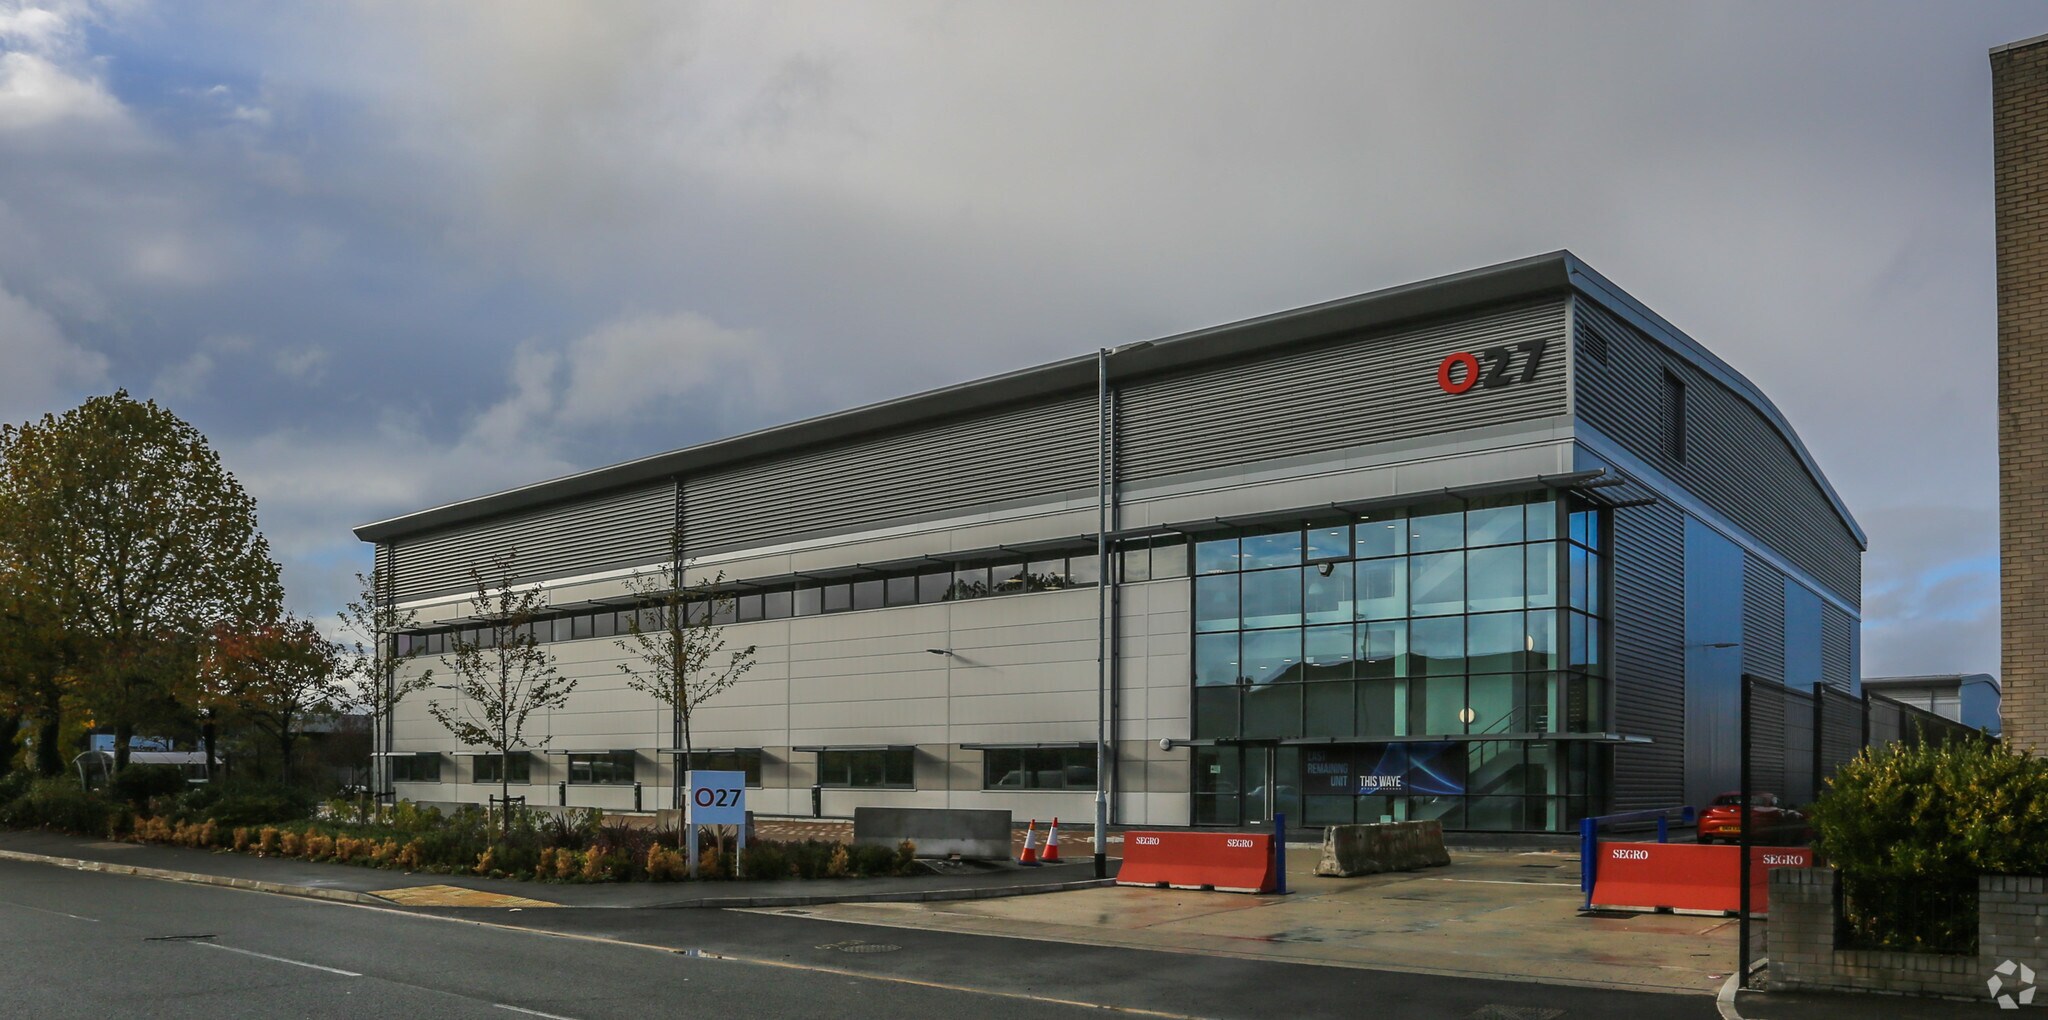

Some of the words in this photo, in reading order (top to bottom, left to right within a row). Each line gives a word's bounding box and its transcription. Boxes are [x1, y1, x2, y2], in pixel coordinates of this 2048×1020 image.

[1307, 763, 1348, 774] REMAINING
[1330, 775, 1348, 787] UNIT
[1360, 775, 1377, 787] THIS
[1379, 775, 1401, 787] WAYE
[1136, 836, 1160, 846] SEGRO
[1227, 839, 1253, 848] SEGRO
[1612, 849, 1649, 860] SEGRO
[1763, 854, 1804, 866] SEGRO
